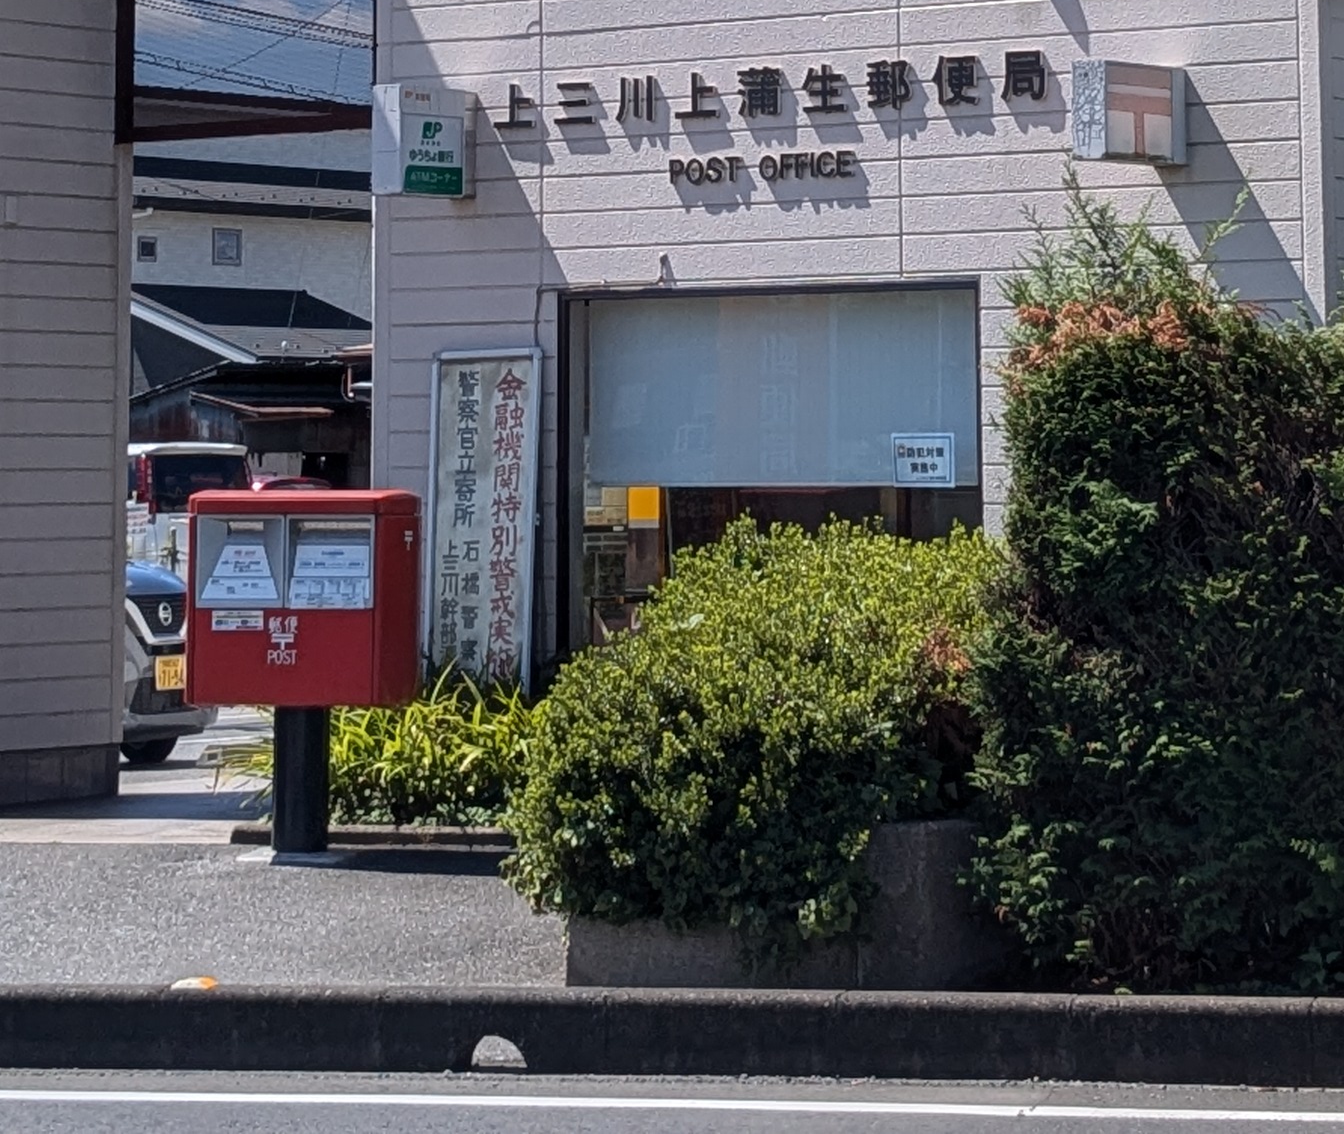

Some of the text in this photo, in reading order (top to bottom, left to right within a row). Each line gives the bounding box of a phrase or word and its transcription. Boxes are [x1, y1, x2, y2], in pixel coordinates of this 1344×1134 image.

[494, 50, 1049, 128] 上三川上蒲生郵便局
[422, 122, 443, 139] JP
[409, 149, 453, 163] ゆうちょ銀行
[669, 151, 856, 185] POST OFFICE
[410, 171, 458, 183] ATMコーナー
[453, 370, 479, 528] 警察官立寄所
[269, 616, 298, 633] 郵便
[267, 649, 298, 665] POST
